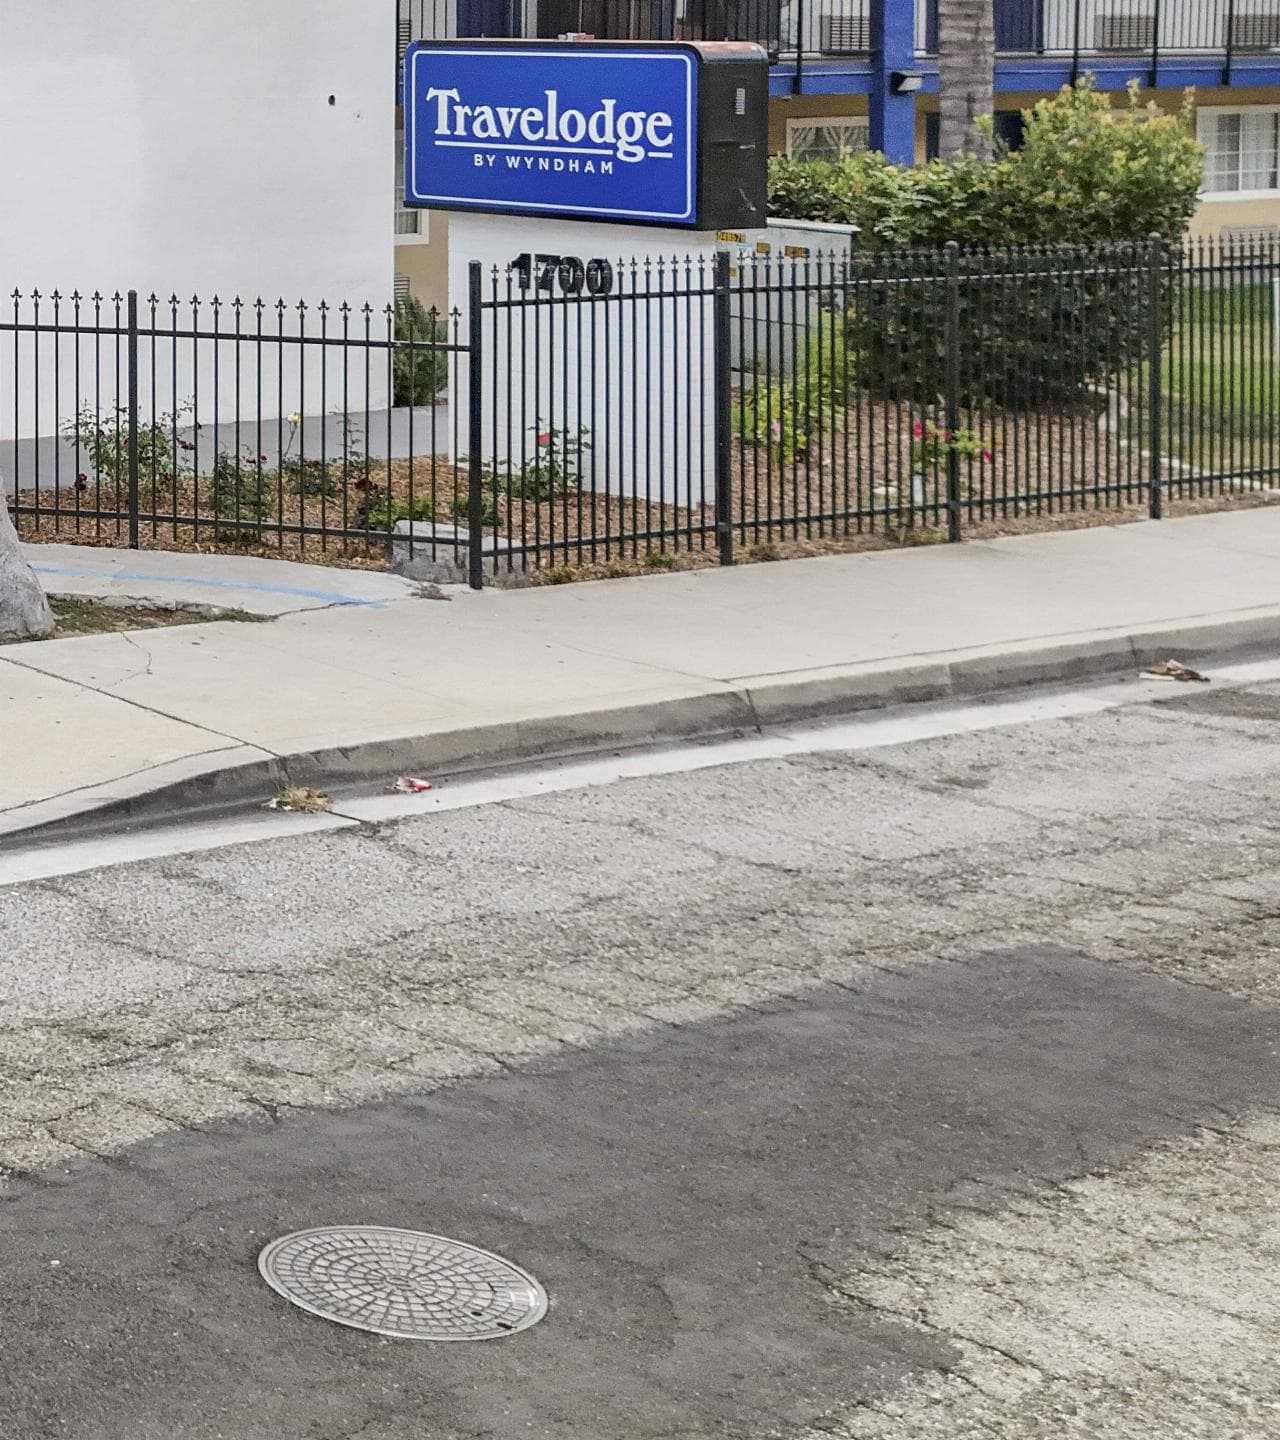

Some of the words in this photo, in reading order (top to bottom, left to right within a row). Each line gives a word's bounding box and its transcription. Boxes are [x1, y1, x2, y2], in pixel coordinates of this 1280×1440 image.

[426, 87, 673, 162] Travelodge
[474, 153, 496, 167] BY
[506, 155, 613, 175] WYNDHAM
[511, 252, 613, 294] 1700
